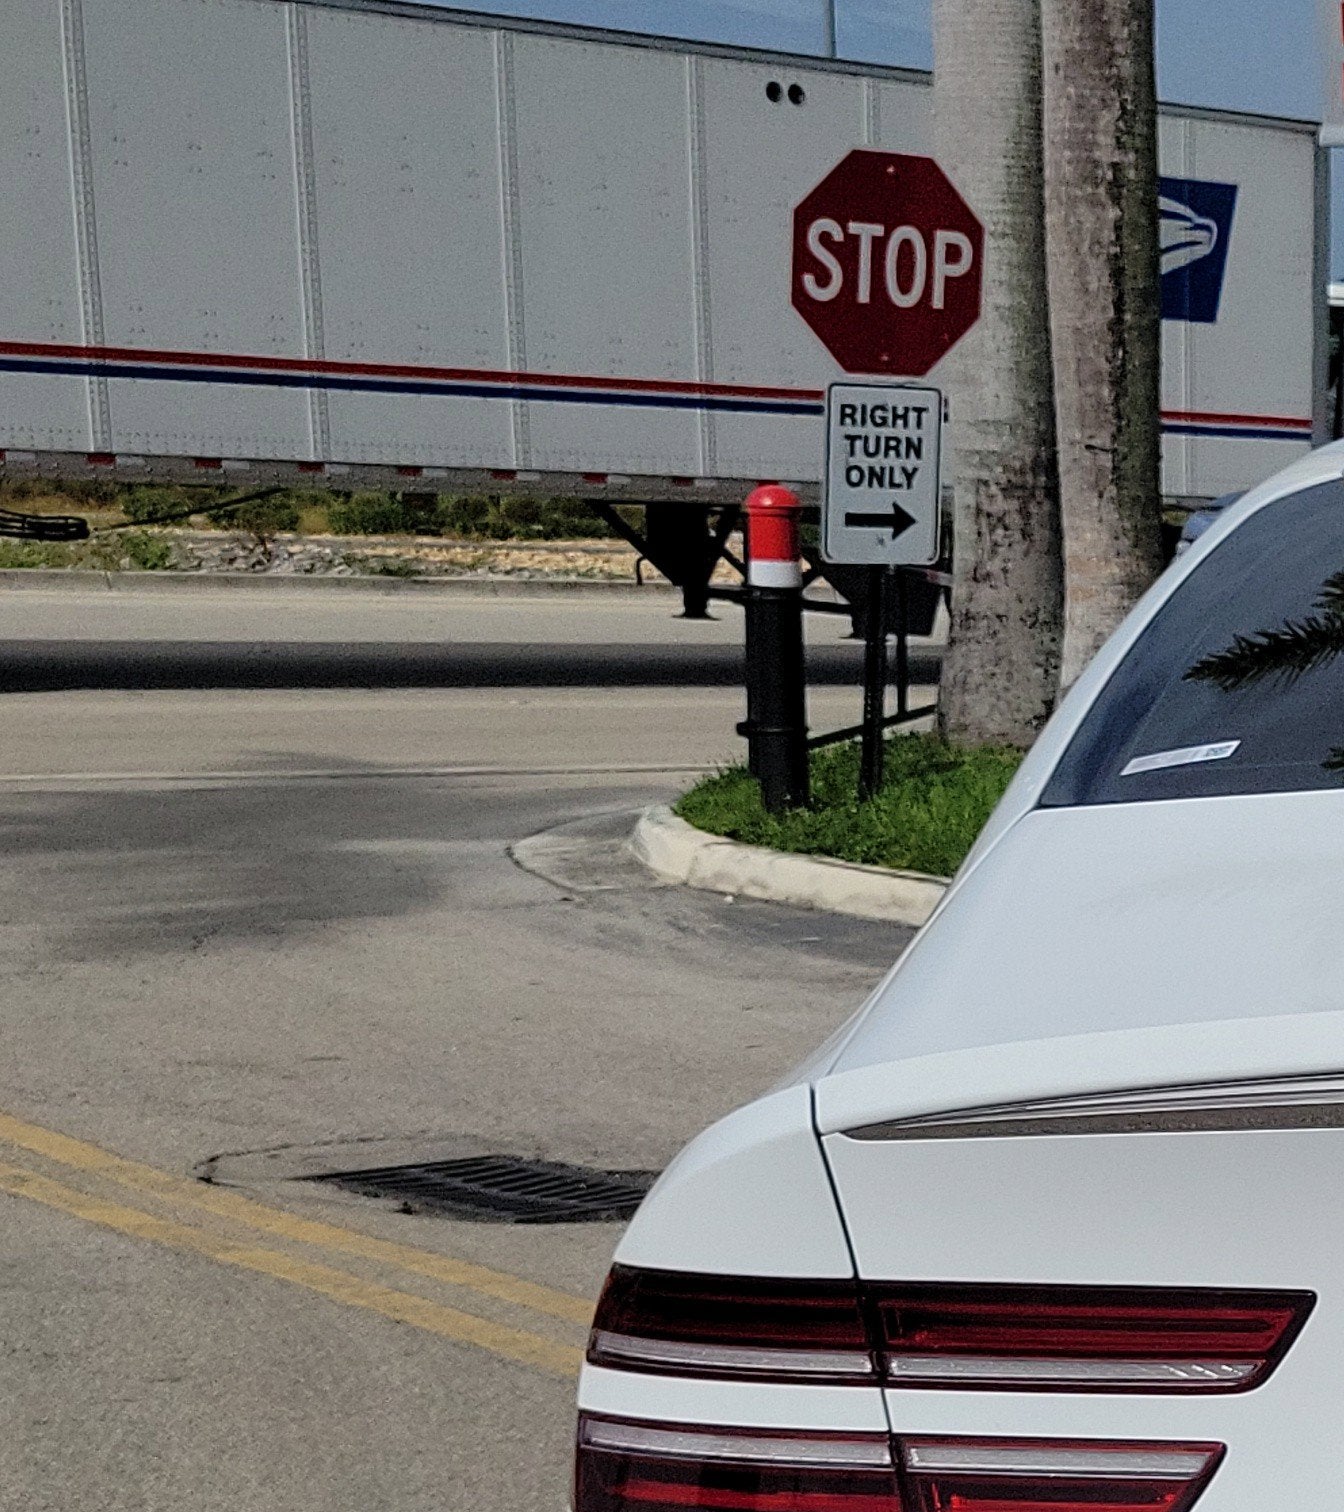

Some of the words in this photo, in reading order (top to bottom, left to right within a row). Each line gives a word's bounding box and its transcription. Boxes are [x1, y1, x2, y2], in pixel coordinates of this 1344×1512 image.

[802, 217, 974, 310] STOP
[839, 403, 930, 430] RIGHT
[844, 434, 923, 460] TURN
[845, 465, 919, 490] ONLY
